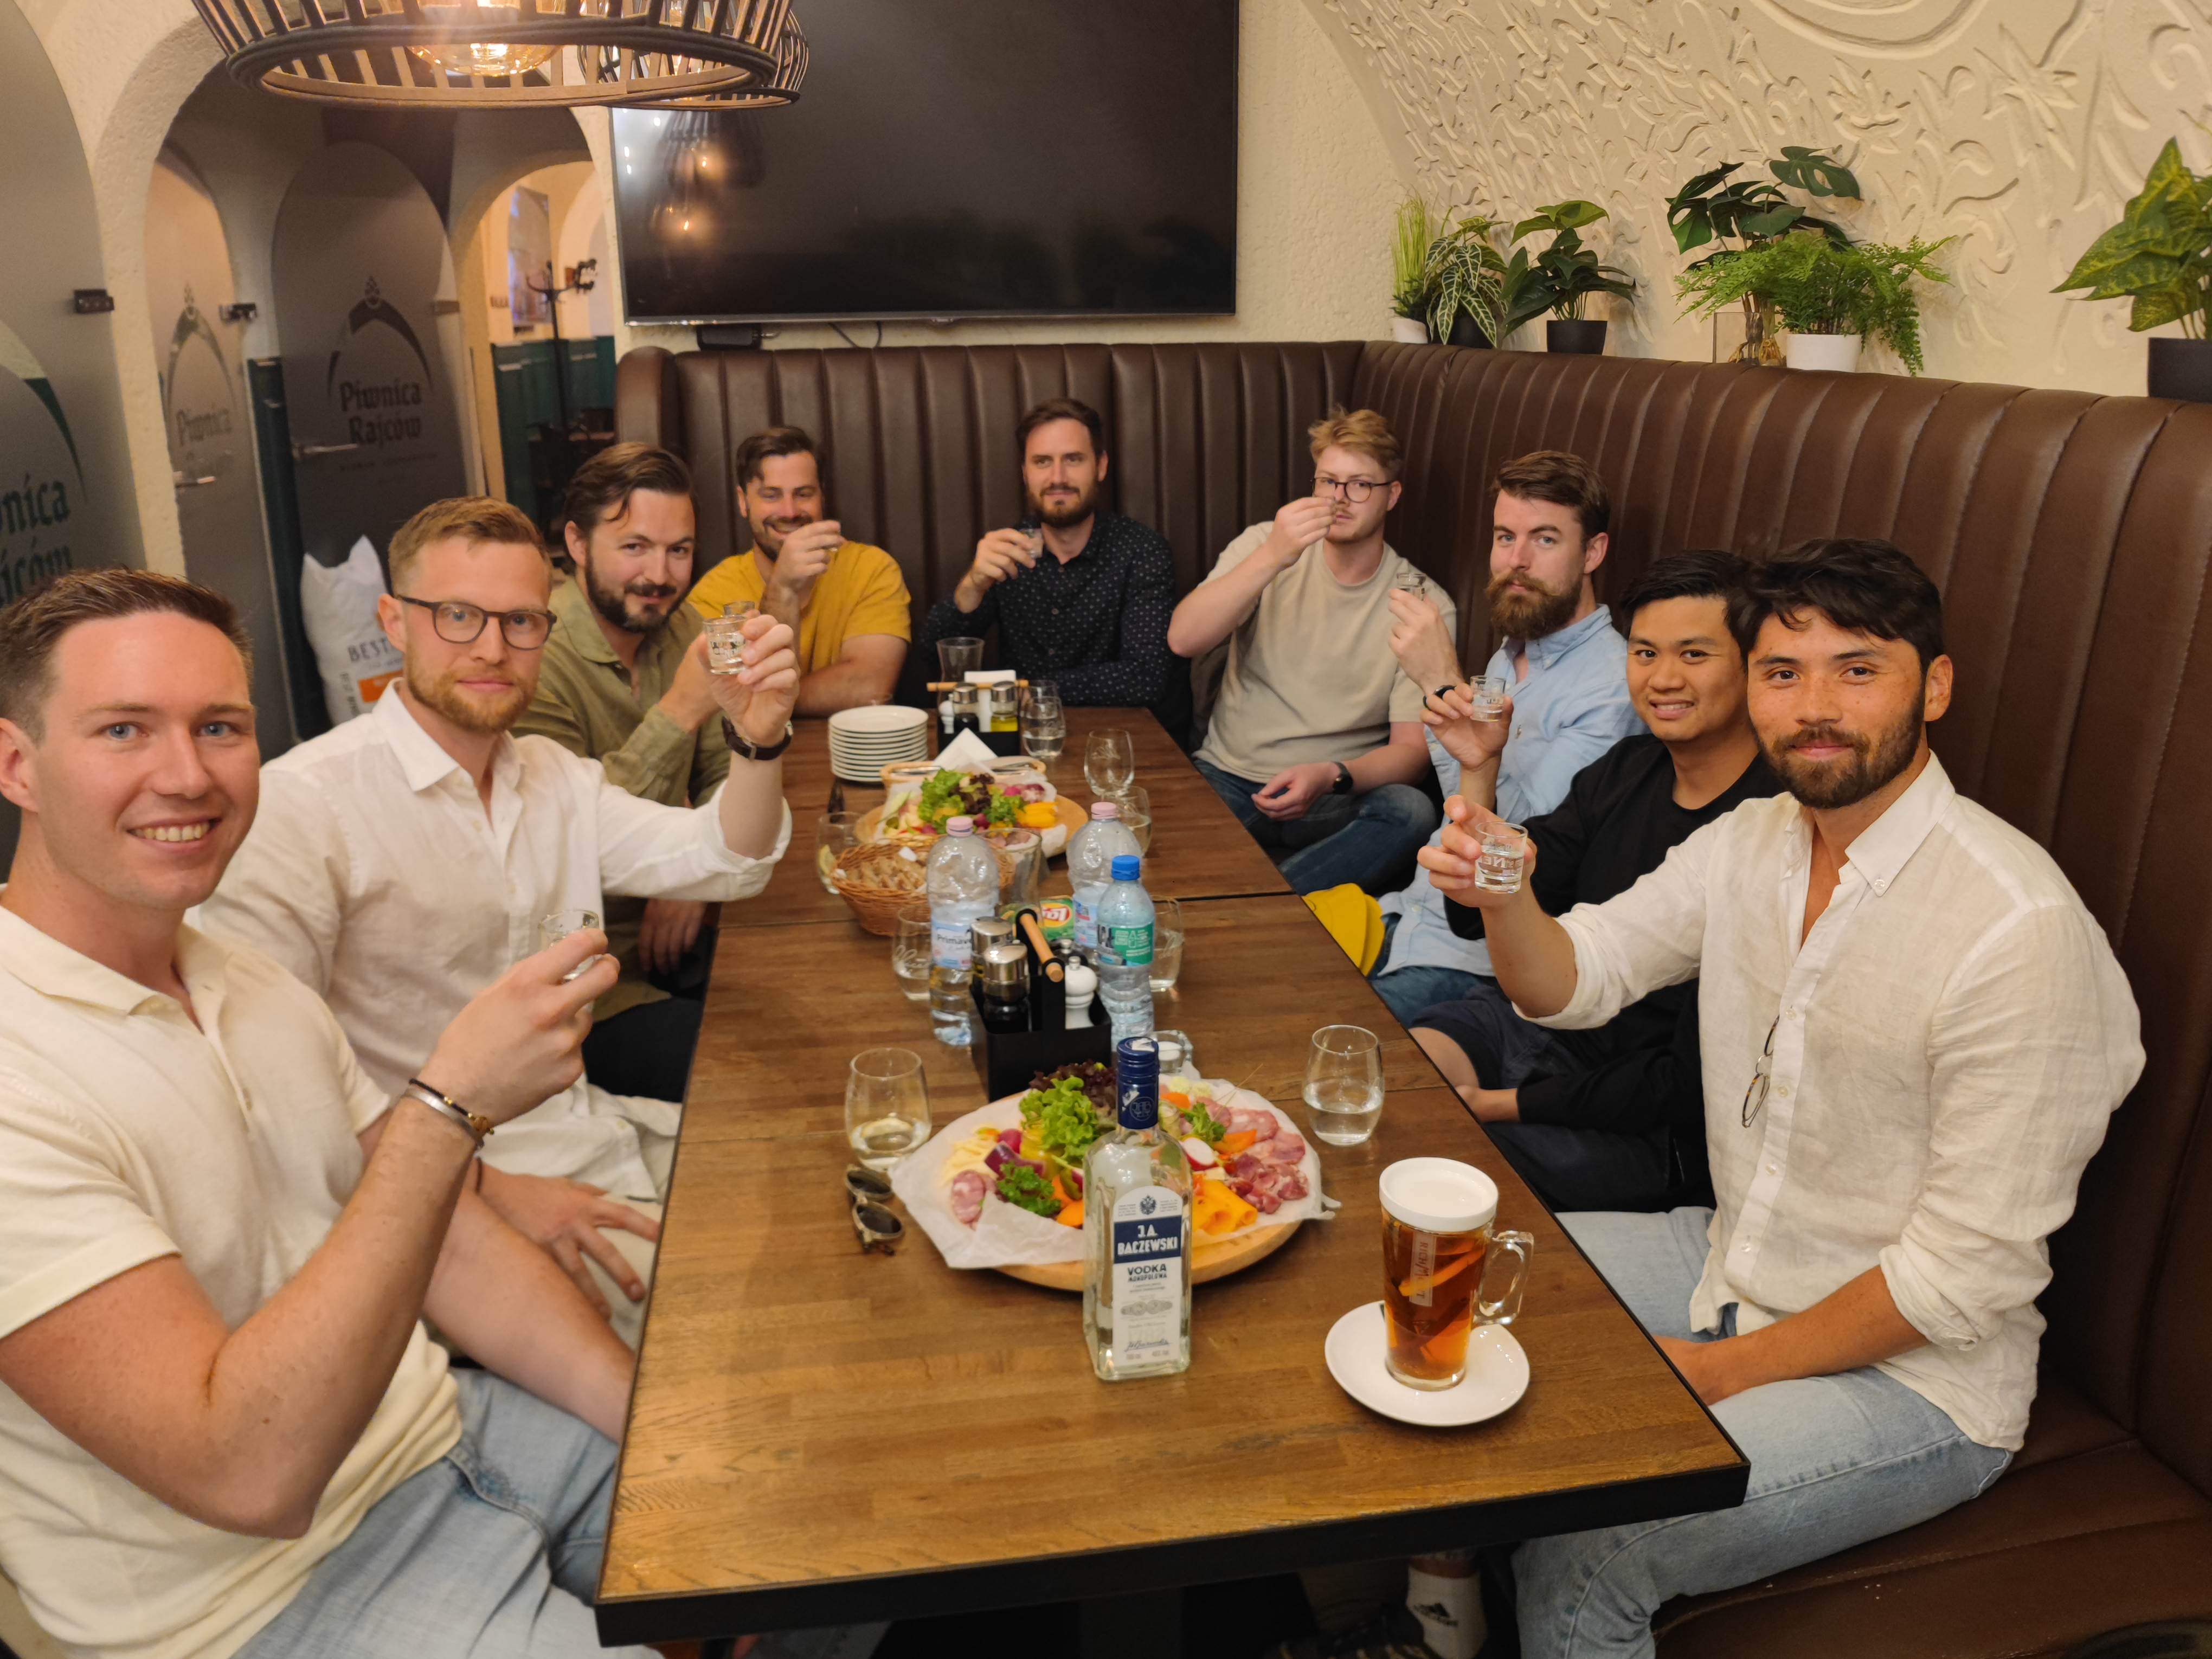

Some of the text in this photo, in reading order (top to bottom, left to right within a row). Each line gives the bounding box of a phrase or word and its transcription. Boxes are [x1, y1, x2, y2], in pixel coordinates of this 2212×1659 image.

[0, 472, 70, 534] nica
[1117, 1236, 1178, 1256] BACZEWSKI
[1127, 1263, 1167, 1276] VODKA
